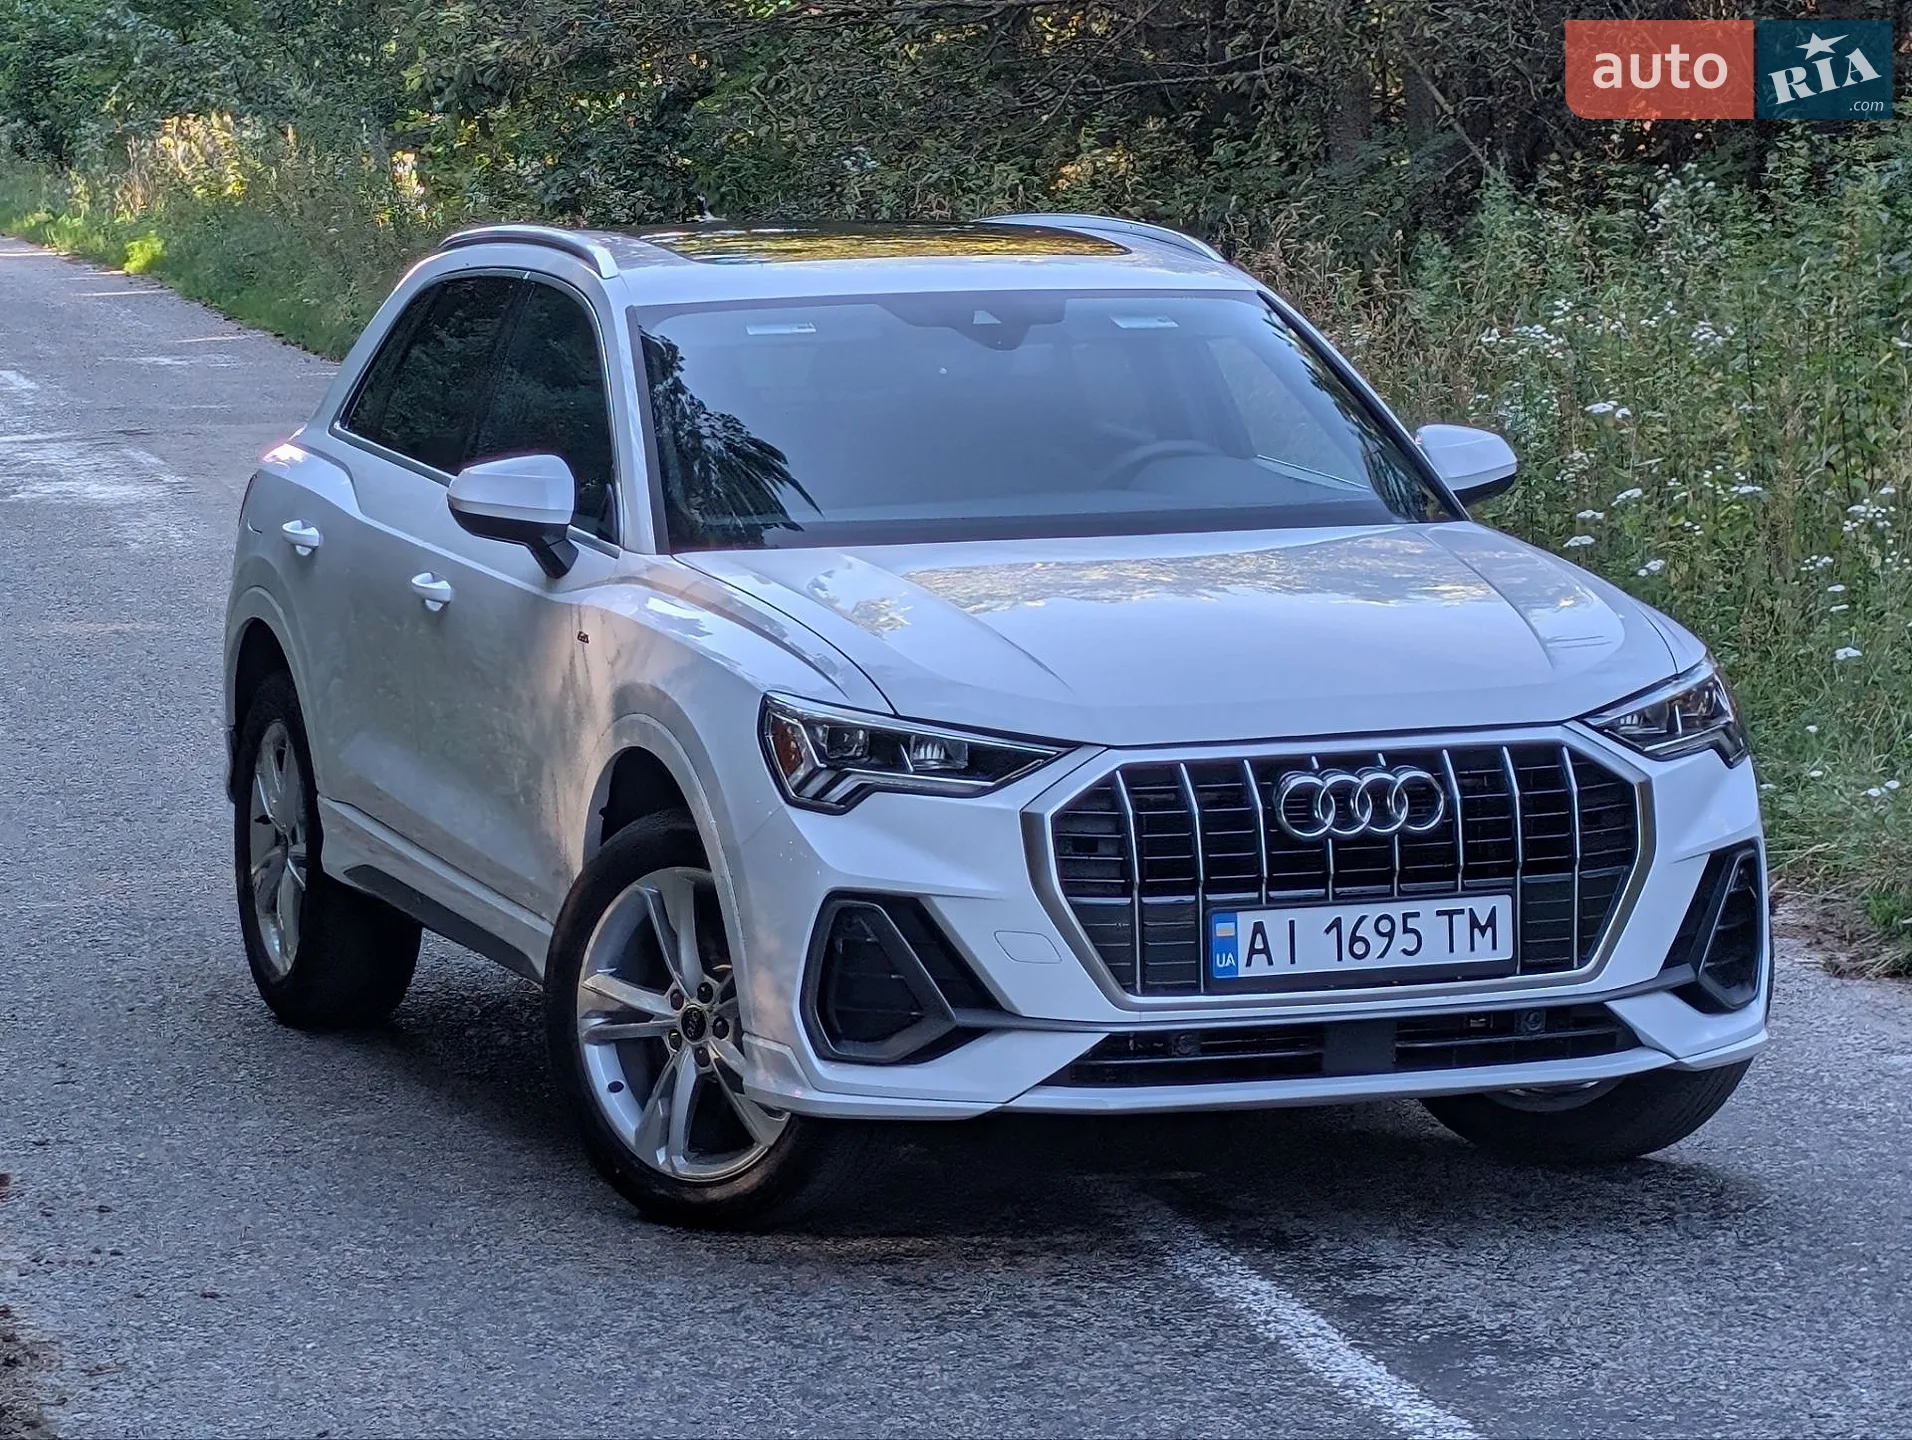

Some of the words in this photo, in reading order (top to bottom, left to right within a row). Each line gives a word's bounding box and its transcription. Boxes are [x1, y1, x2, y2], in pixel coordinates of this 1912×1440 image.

[1245, 919, 1296, 967] AI
[1323, 911, 1423, 962] 1695
[1435, 905, 1497, 953] TM
[1216, 953, 1236, 968] UA
